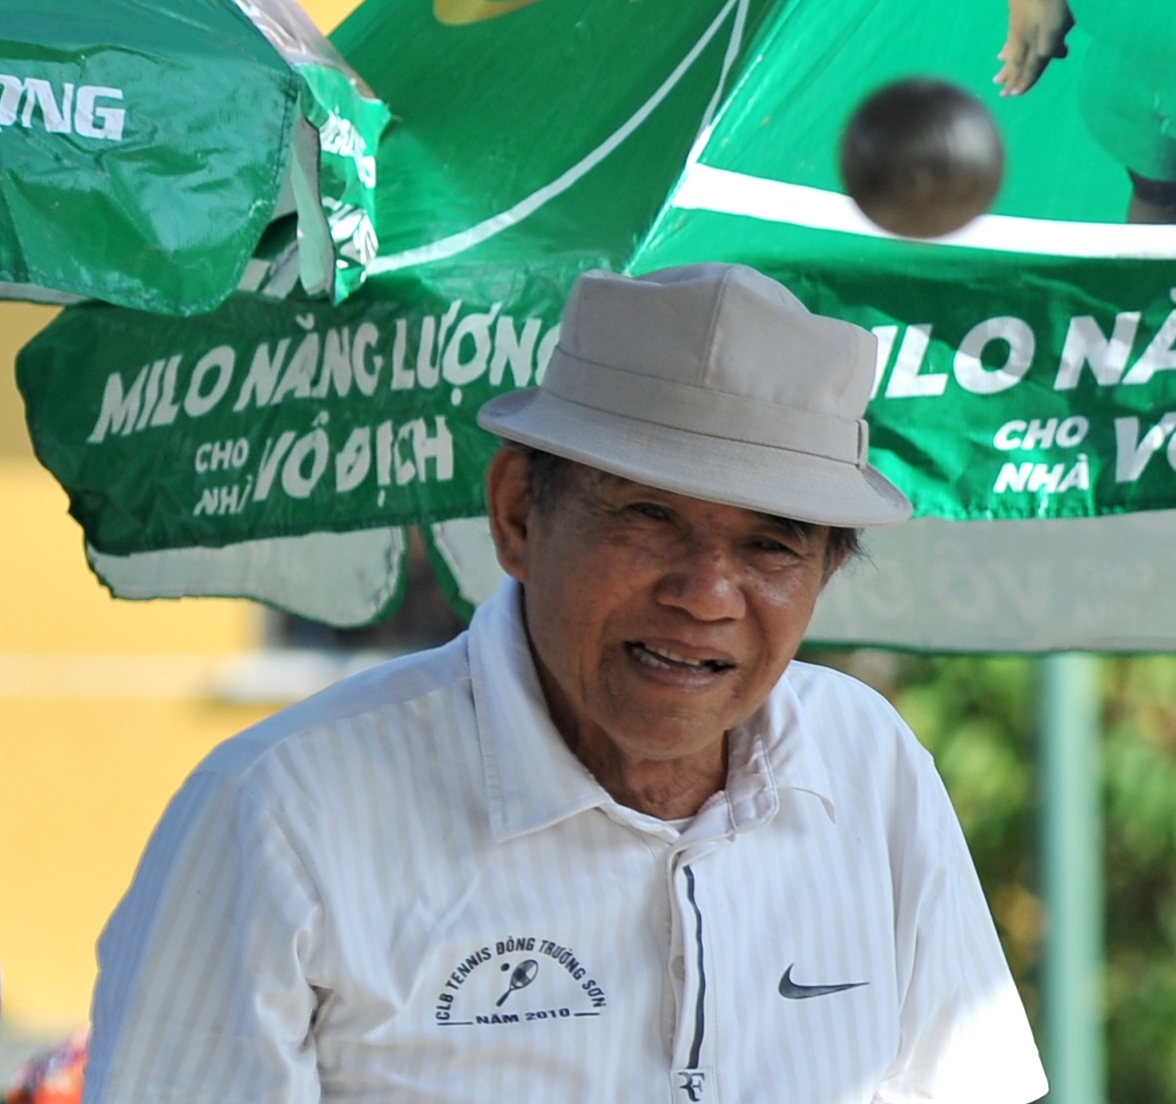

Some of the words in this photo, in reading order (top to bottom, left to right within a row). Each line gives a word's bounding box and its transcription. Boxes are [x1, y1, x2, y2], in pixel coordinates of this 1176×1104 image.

[86, 344, 235, 443] MILO
[233, 312, 383, 412] NĂNG
[869, 315, 1036, 400] ILO
[194, 437, 249, 473] CHO
[335, 415, 454, 507] ĐỊCH
[993, 415, 1089, 451] CHO
[993, 453, 1090, 493] NHÀ
[436, 993, 454, 1021] CLB
[445, 947, 492, 990] TENNIS
[581, 979, 607, 1008] SƠN
[525, 1008, 570, 1021] 2010
